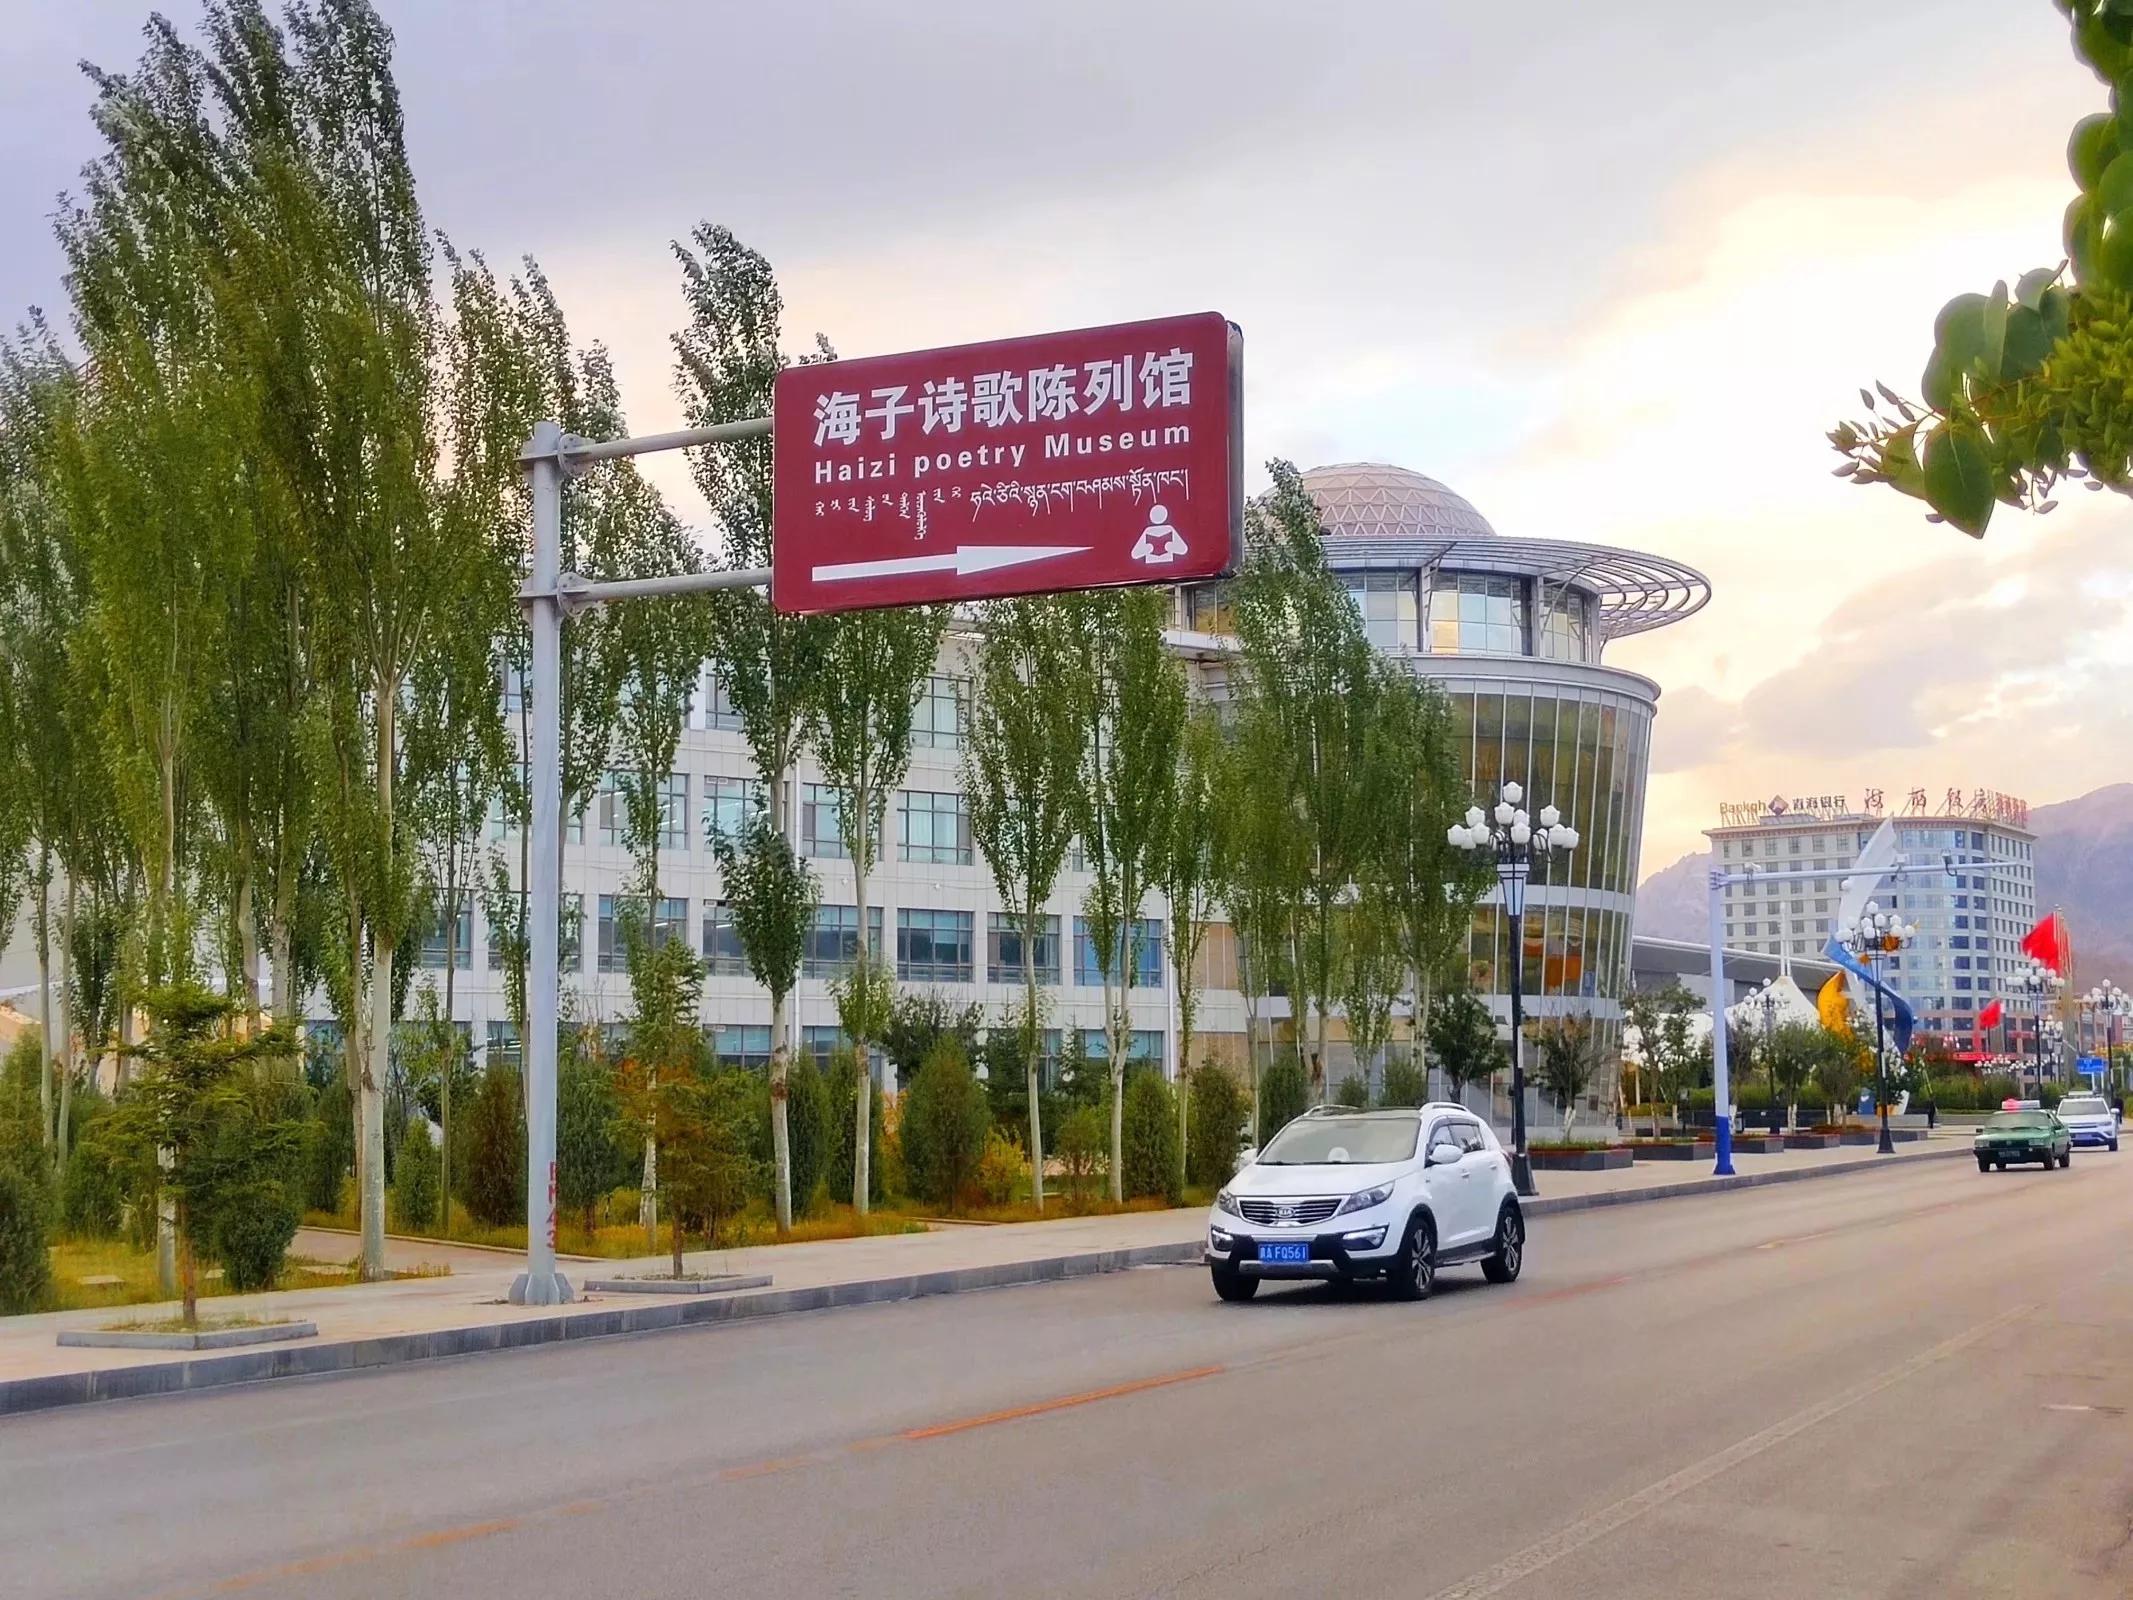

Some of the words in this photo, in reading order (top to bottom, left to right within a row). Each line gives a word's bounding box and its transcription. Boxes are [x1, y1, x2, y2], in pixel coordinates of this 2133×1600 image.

[813, 348, 1194, 447] 海子诗歌陈列馆
[815, 452, 896, 484] Haizi
[914, 444, 1026, 479] poetry
[1045, 425, 1190, 459] Museum
